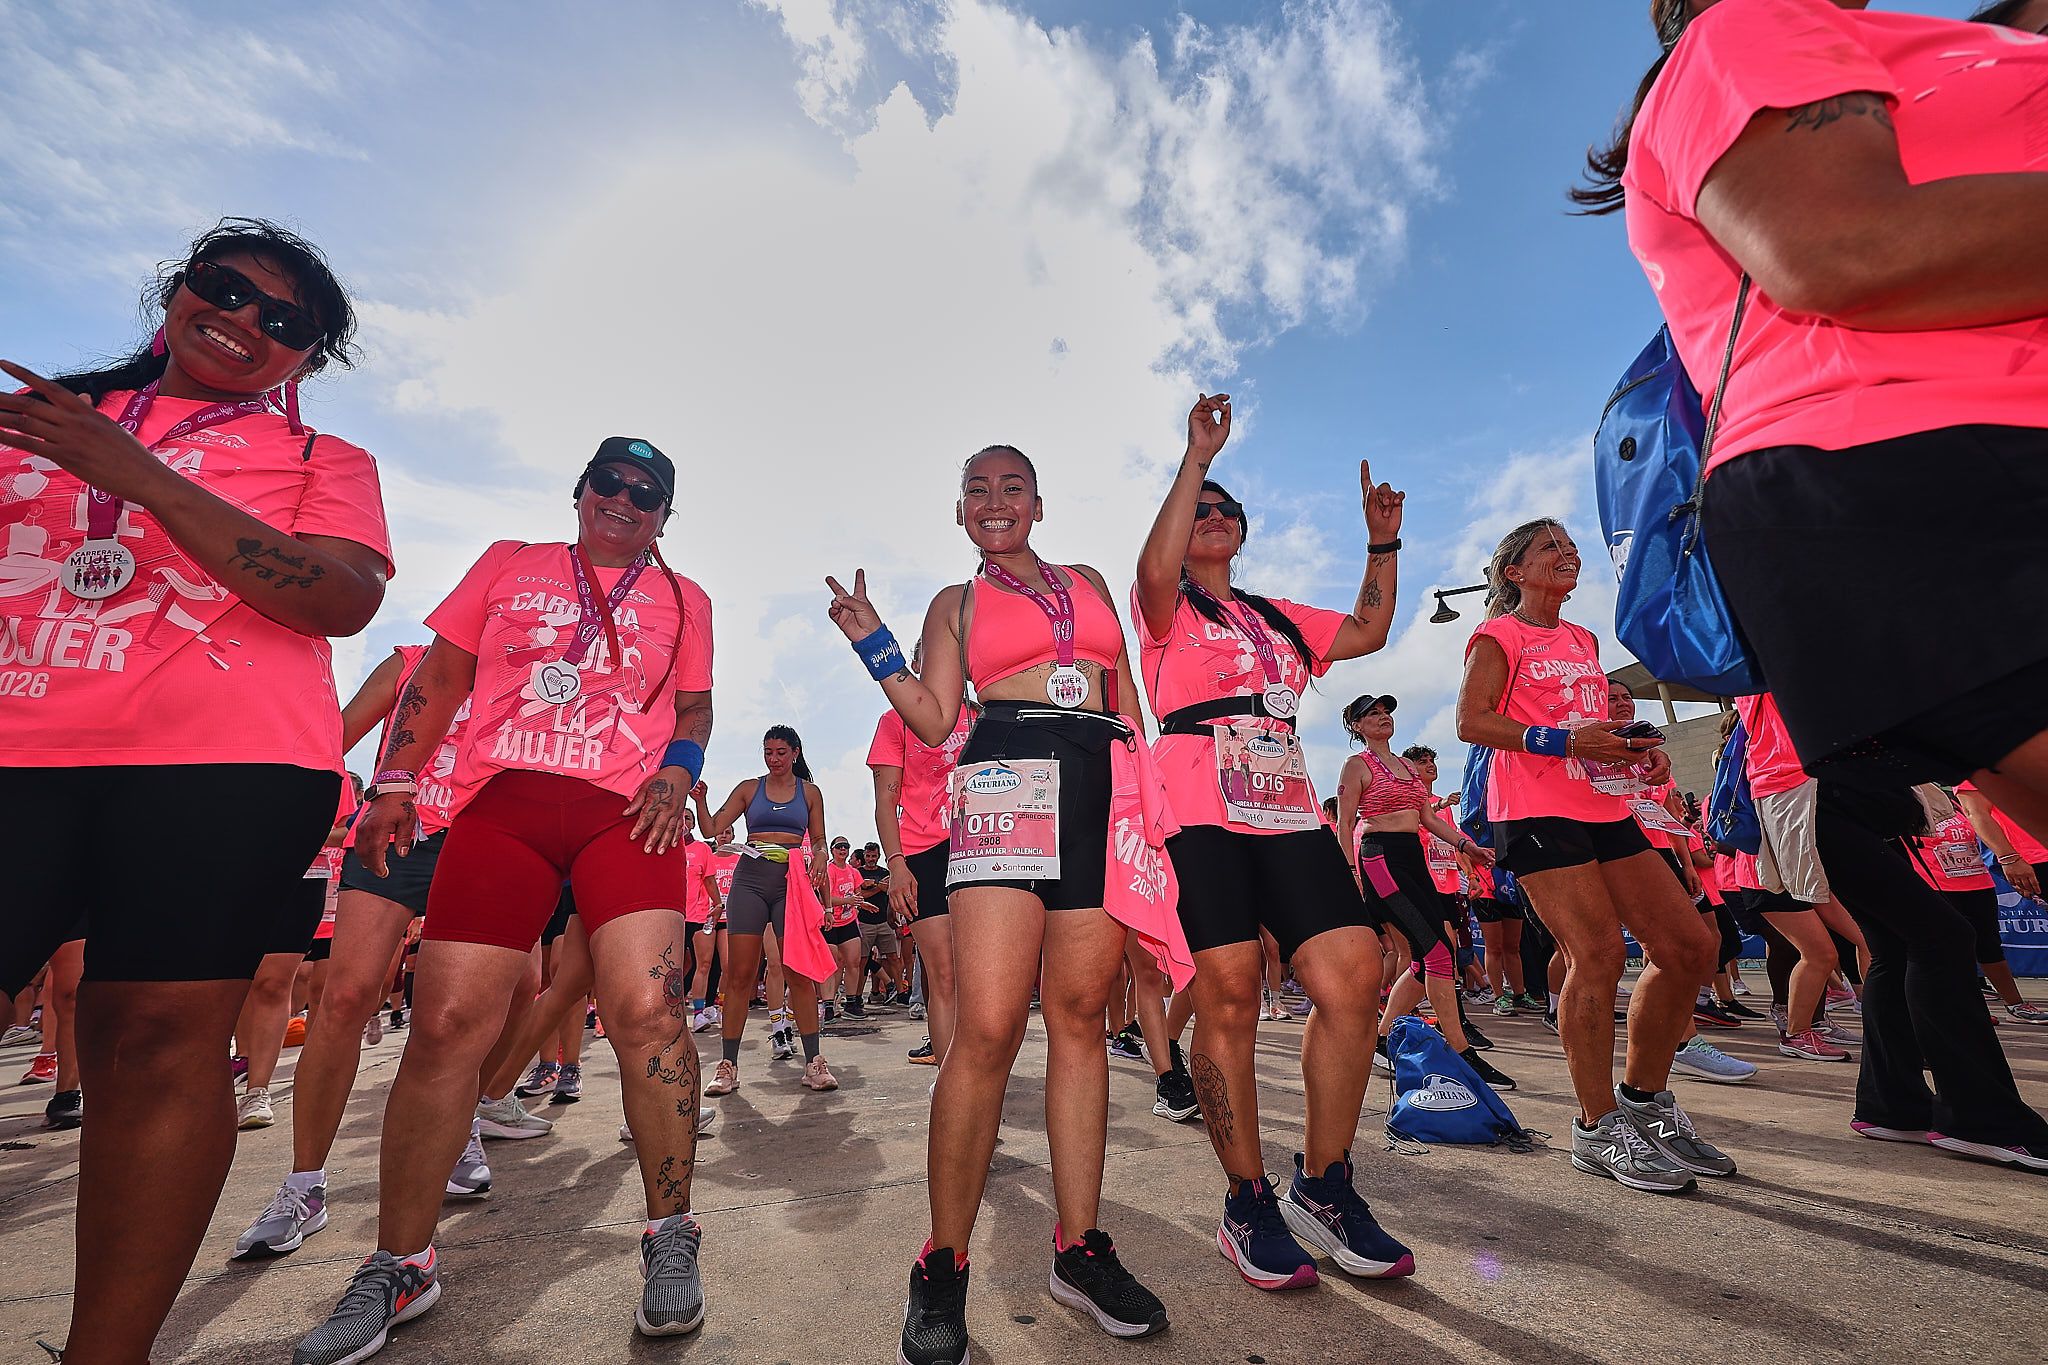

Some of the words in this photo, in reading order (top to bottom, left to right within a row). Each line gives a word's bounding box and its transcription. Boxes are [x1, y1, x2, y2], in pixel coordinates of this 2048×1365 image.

[70, 554, 123, 567] MUJER
[75, 550, 111, 558] CARRERA
[517, 576, 571, 591] OYSHO
[511, 592, 640, 627] CARRRA
[0, 616, 133, 672] UJER
[0, 671, 50, 698] 026
[1051, 677, 1081, 685] MUJER
[1581, 684, 1599, 713] DE
[552, 699, 587, 735] LA
[490, 729, 604, 770] MUJER
[1250, 742, 1283, 754] ASTURIANA
[970, 779, 1017, 789] ASTURIANA
[1252, 772, 1285, 792] 016
[967, 813, 1015, 834] 016
[1280, 817, 1308, 825] Santander
[1950, 828, 1966, 841] DE
[979, 837, 1001, 847] 2908
[967, 849, 975, 857] DE
[976, 848, 984, 856] LA
[986, 847, 1006, 855] MUJER
[1012, 847, 1044, 855] VALENCIA
[1003, 863, 1044, 872] Santander
[1413, 1091, 1474, 1103] ASTURIANA
